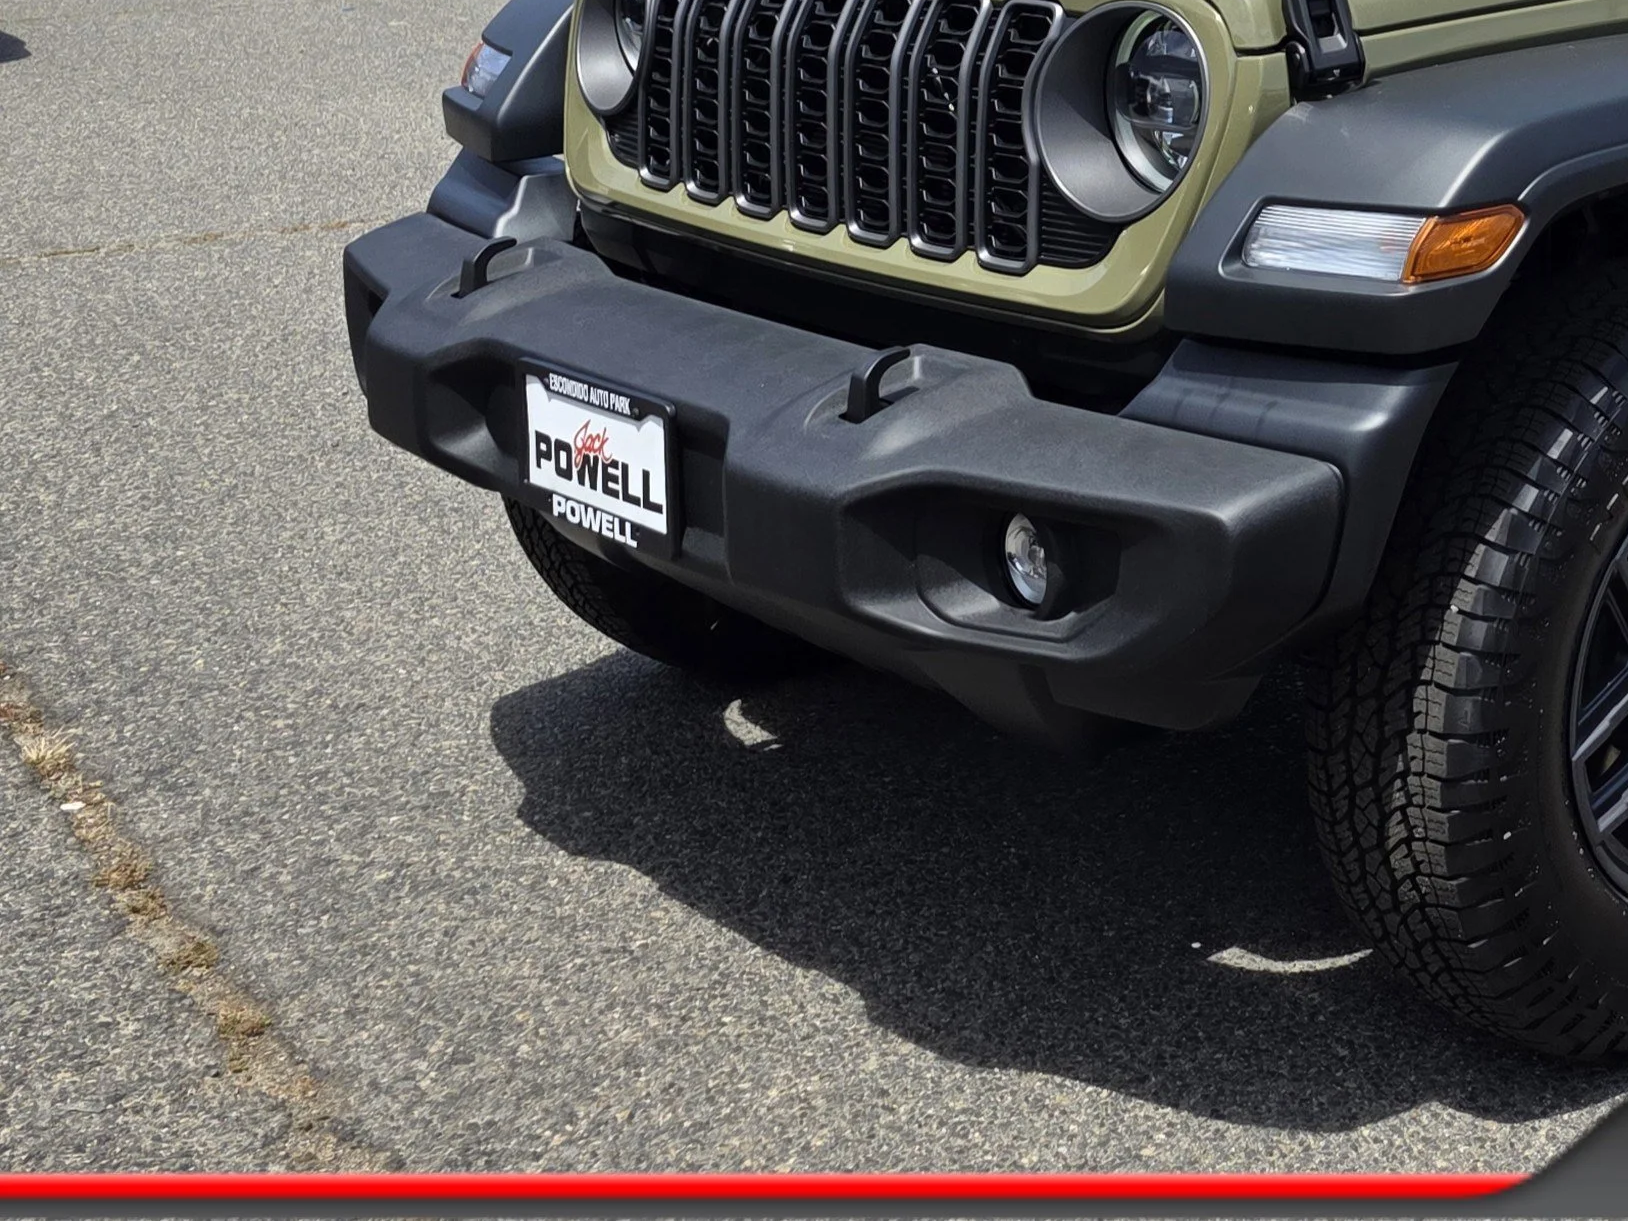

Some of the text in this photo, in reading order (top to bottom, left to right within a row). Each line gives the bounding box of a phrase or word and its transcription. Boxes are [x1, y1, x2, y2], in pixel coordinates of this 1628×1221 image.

[548, 372, 632, 416] ESCONDIDO AUTO PARK
[573, 418, 614, 469] Jack
[534, 429, 664, 515] POWELL
[551, 493, 638, 549] POWELL
